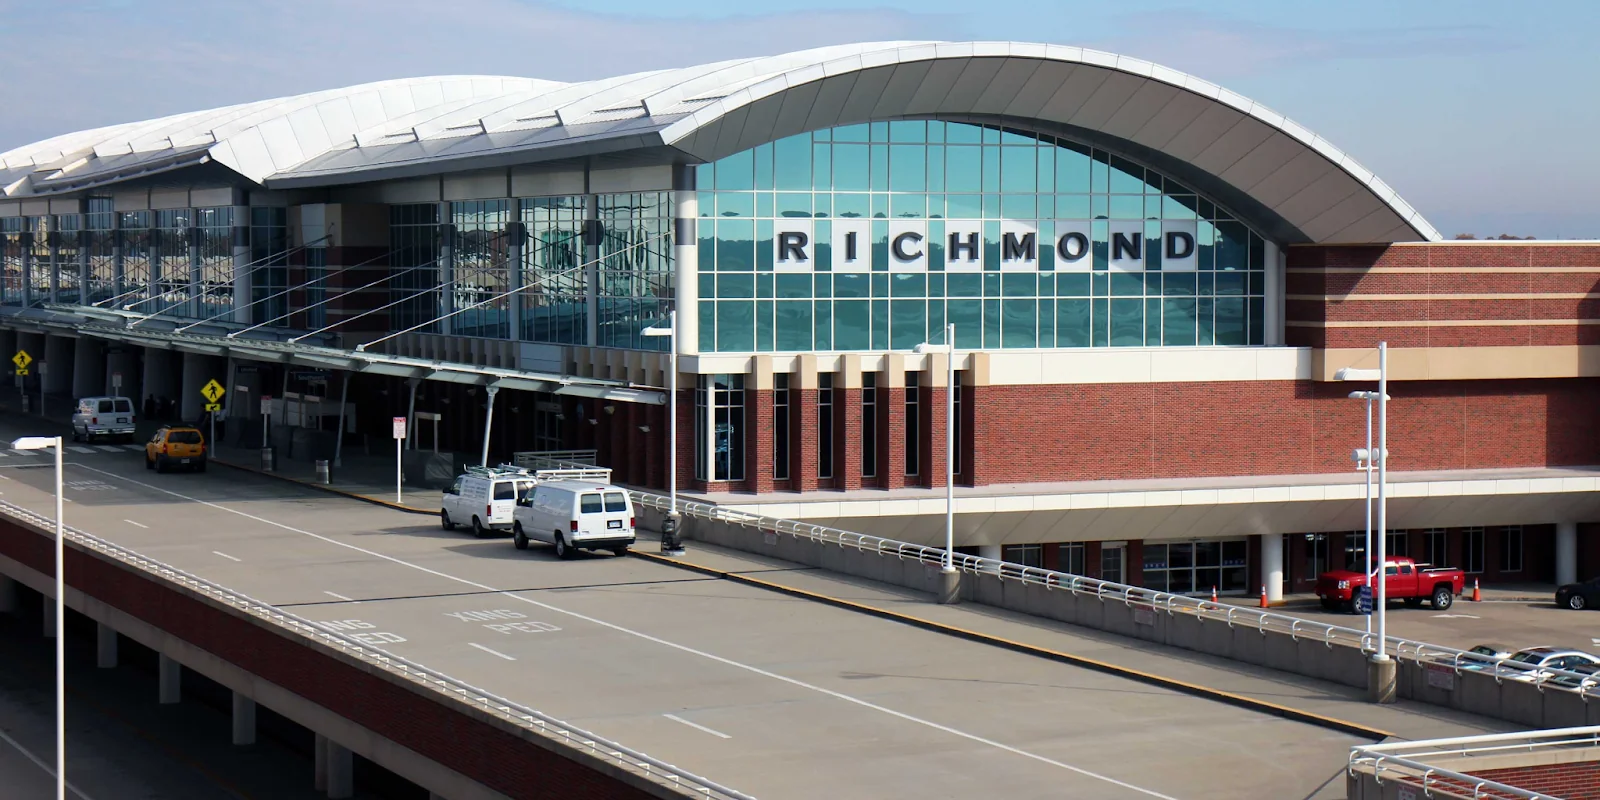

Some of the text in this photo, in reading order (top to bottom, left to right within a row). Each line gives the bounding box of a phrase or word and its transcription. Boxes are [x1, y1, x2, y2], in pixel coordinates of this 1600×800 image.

[778, 231, 1195, 261] RICHMOND
[442, 609, 528, 621] XING
[311, 619, 377, 631] ING
[481, 621, 563, 635] PED
[348, 632, 408, 644] ED
